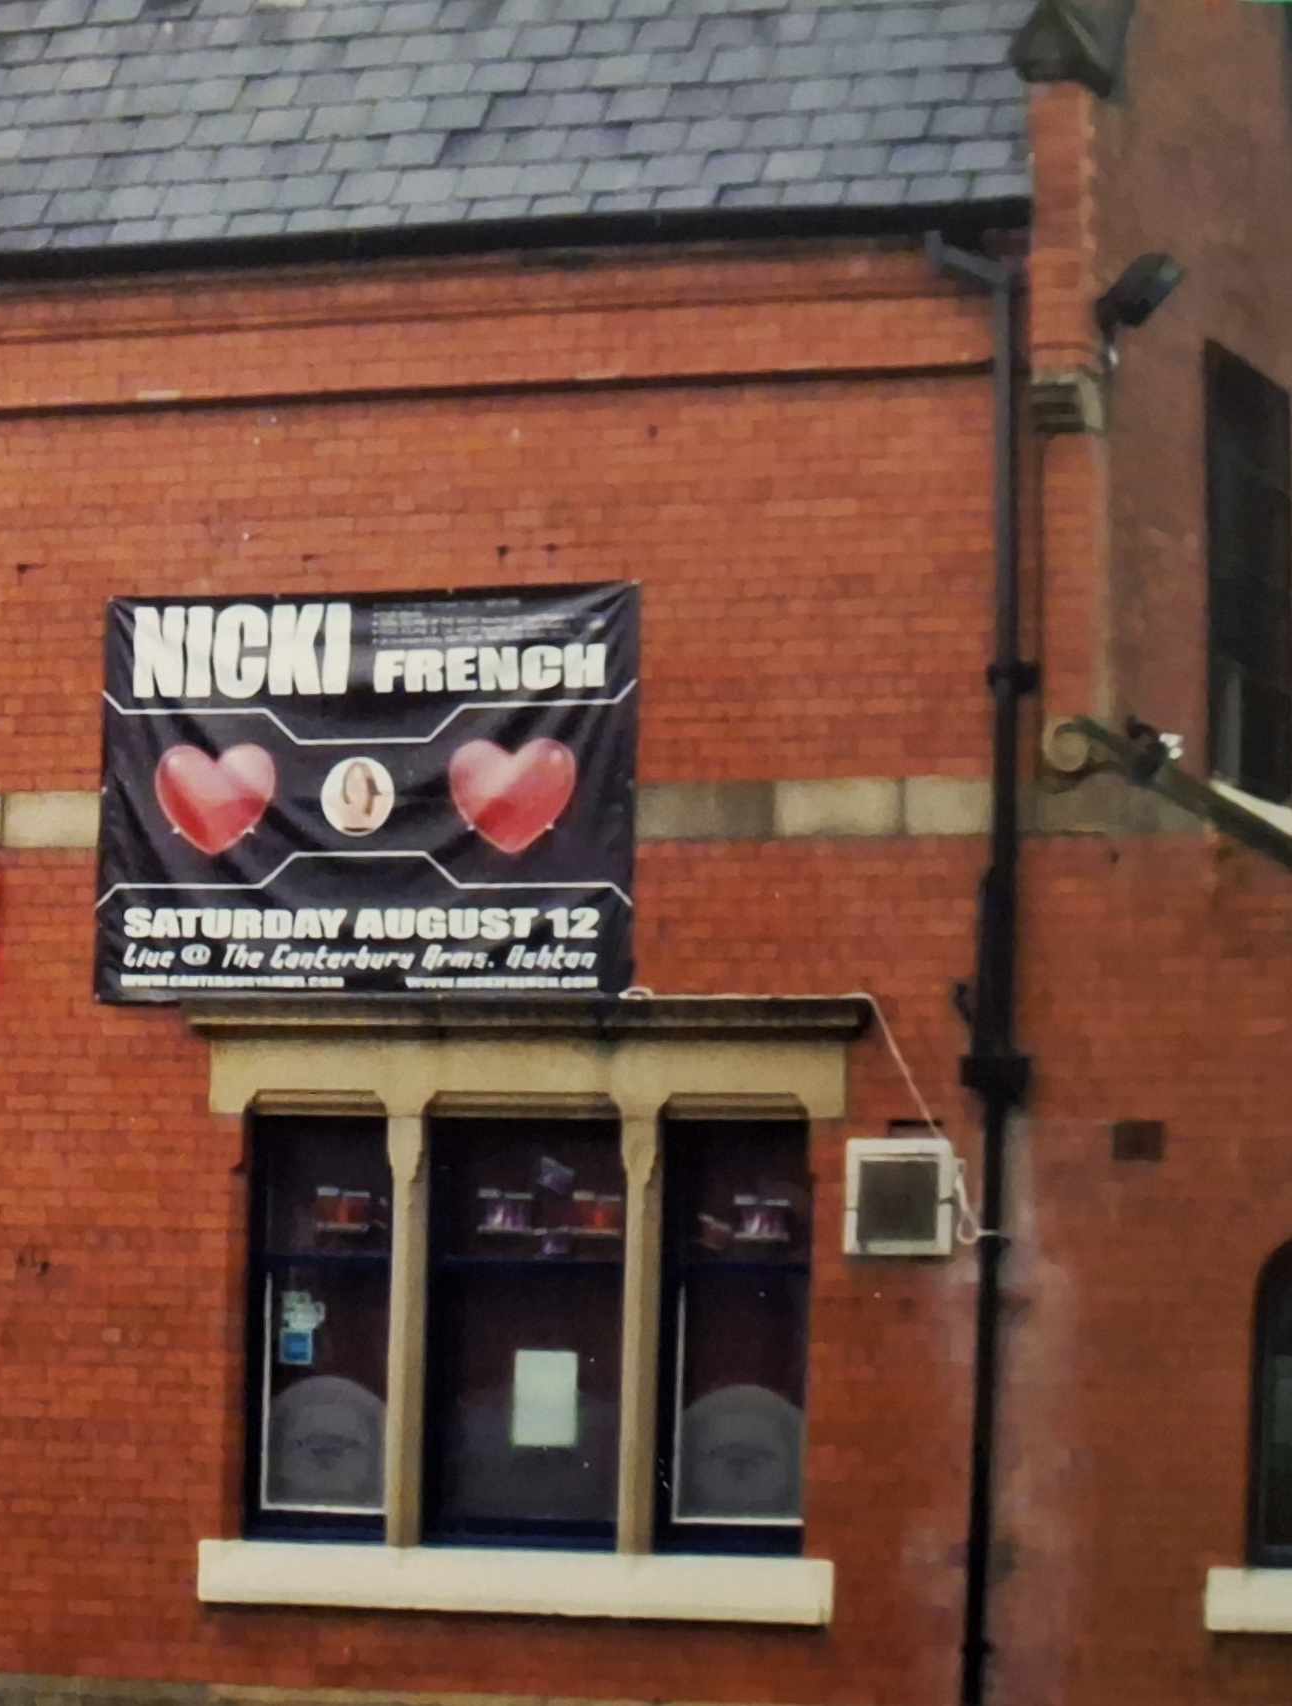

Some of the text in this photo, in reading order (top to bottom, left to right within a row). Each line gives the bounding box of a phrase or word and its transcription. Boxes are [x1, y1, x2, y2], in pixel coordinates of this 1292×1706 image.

[132, 603, 353, 699] NICKI
[372, 643, 607, 693] FRENCH
[123, 907, 600, 940] SATURDAY AUGUST 12
[123, 943, 176, 969] Live
[180, 944, 212, 966] @
[221, 943, 265, 969] The
[269, 943, 416, 971] Canterbury
[505, 944, 597, 970] Ashton
